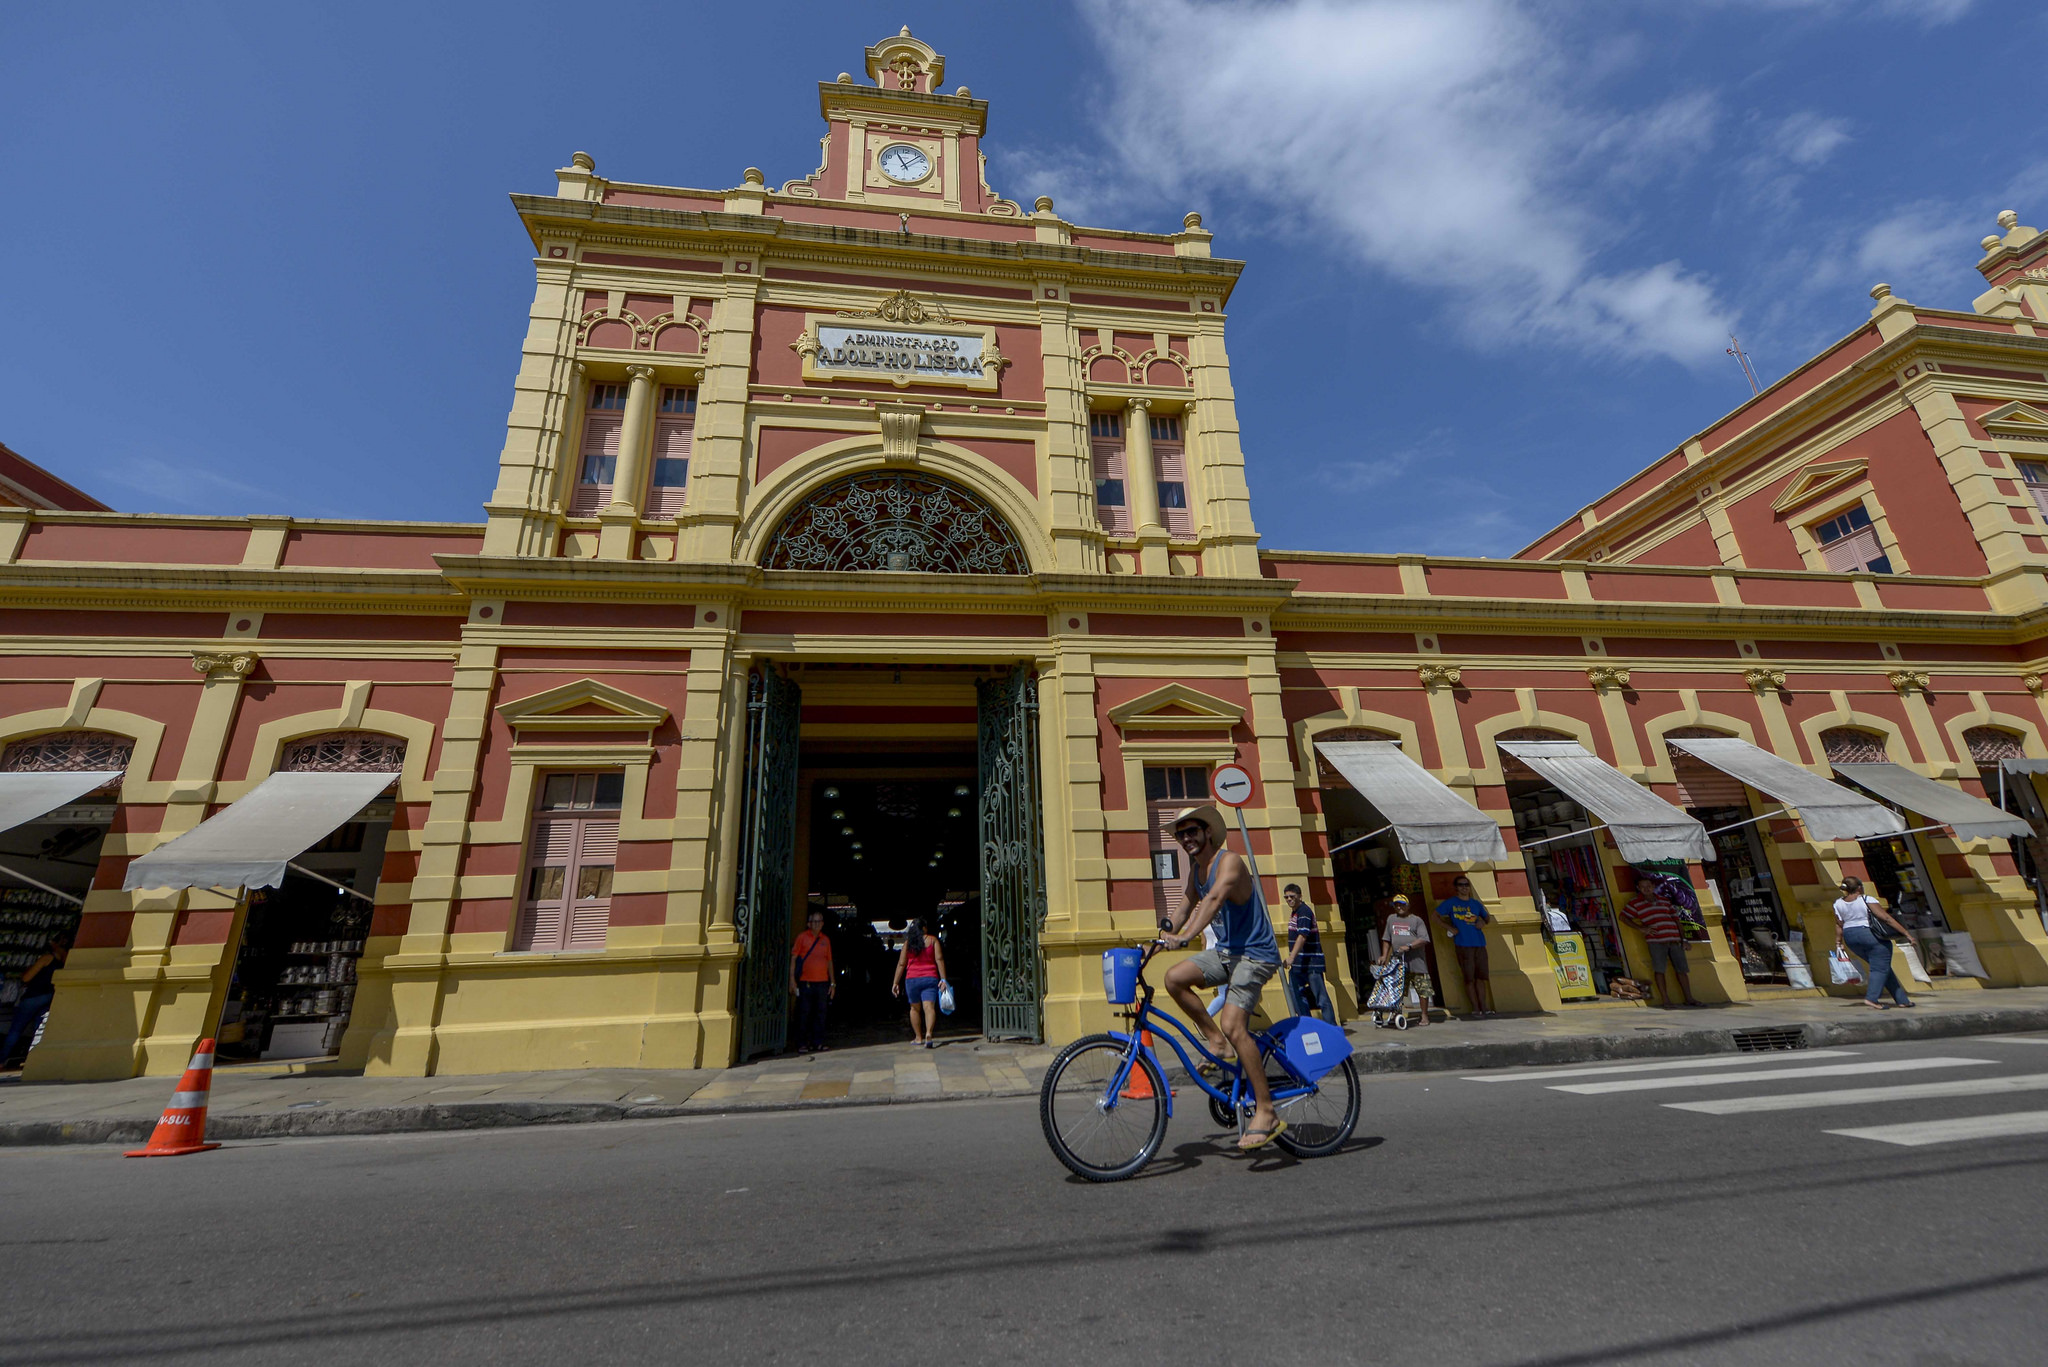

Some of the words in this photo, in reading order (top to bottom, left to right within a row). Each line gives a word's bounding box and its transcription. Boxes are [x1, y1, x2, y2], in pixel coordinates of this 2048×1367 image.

[844, 333, 959, 352] ADMINISTRAÇÃO
[819, 347, 911, 370] ADOLPHO
[914, 353, 984, 376] LISBOA
